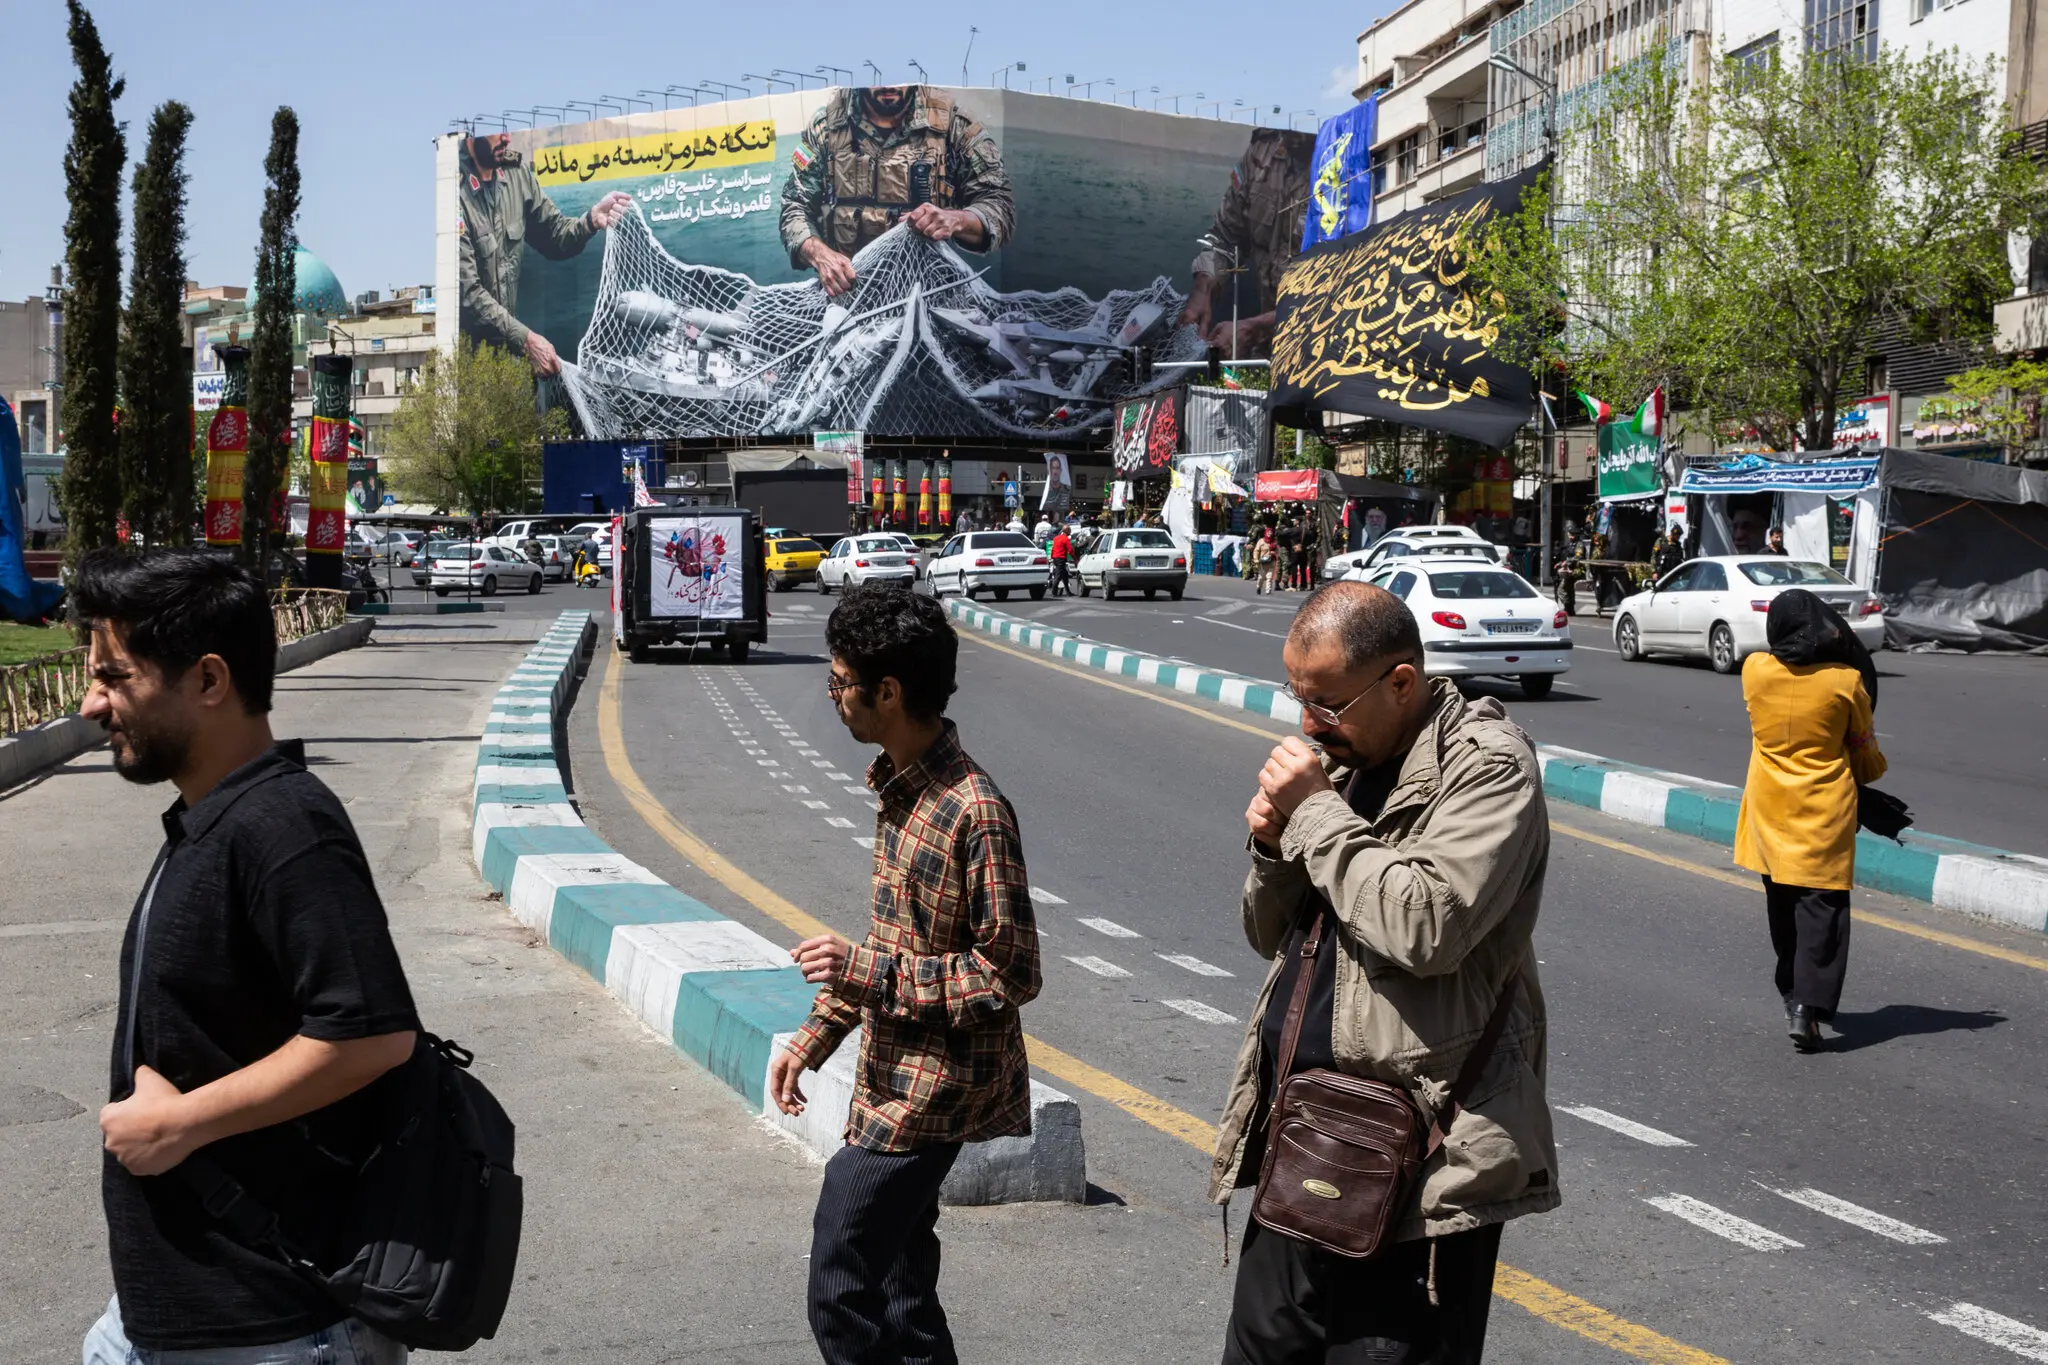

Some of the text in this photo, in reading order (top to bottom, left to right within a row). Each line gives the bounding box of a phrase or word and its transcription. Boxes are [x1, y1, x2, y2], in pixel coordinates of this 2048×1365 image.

[719, 122, 771, 152] تنگه
[612, 145, 664, 170] بسته
[663, 132, 717, 171] هرمز
[675, 171, 717, 200] خلیج
[715, 168, 772, 194] سراسر
[650, 202, 697, 223] ماست
[692, 199, 736, 223] شکار
